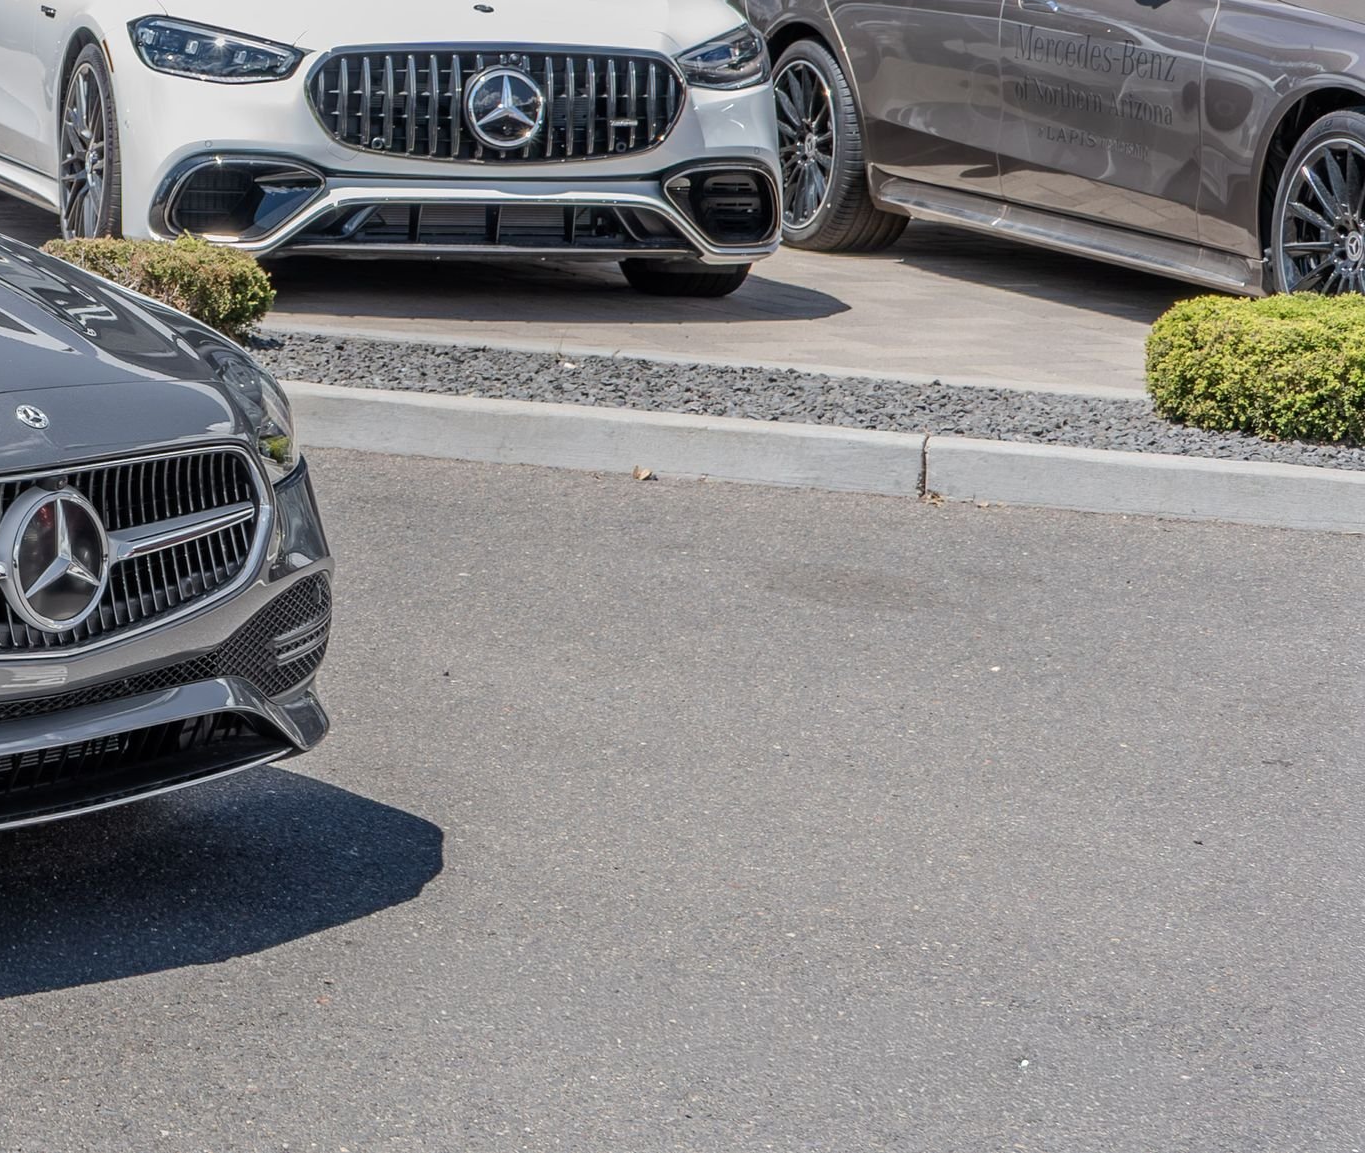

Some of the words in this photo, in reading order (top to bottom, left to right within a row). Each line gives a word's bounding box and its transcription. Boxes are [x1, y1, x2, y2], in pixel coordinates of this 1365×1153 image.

[1014, 24, 1178, 83] Mercedes-Benz
[1014, 75, 1029, 101] of
[1031, 77, 1102, 114] Northern
[1109, 92, 1174, 126] Arizona
[1046, 127, 1097, 149] LAPIS
